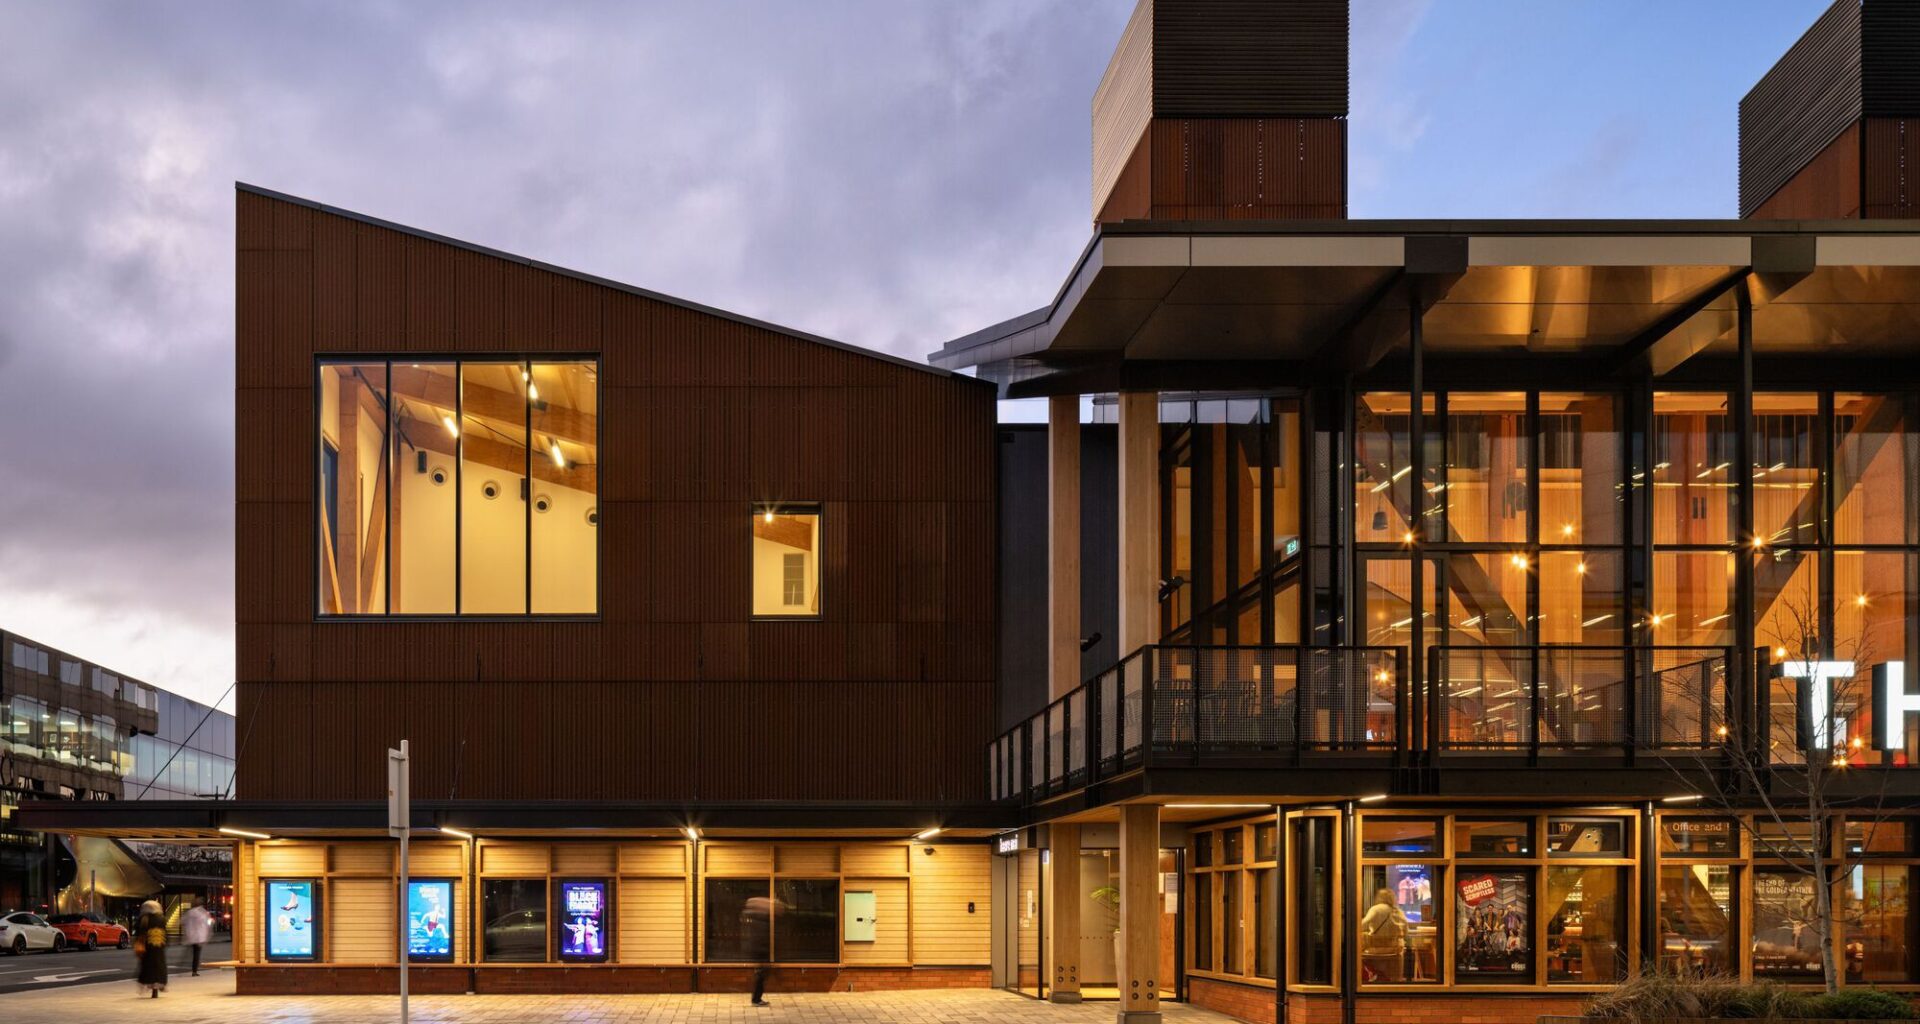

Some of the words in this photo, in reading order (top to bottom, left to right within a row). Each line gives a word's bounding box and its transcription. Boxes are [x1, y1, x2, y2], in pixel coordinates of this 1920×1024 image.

[1672, 822, 1700, 832] Office
[1704, 822, 1722, 832] and
[1463, 879, 1494, 895] SCARED
